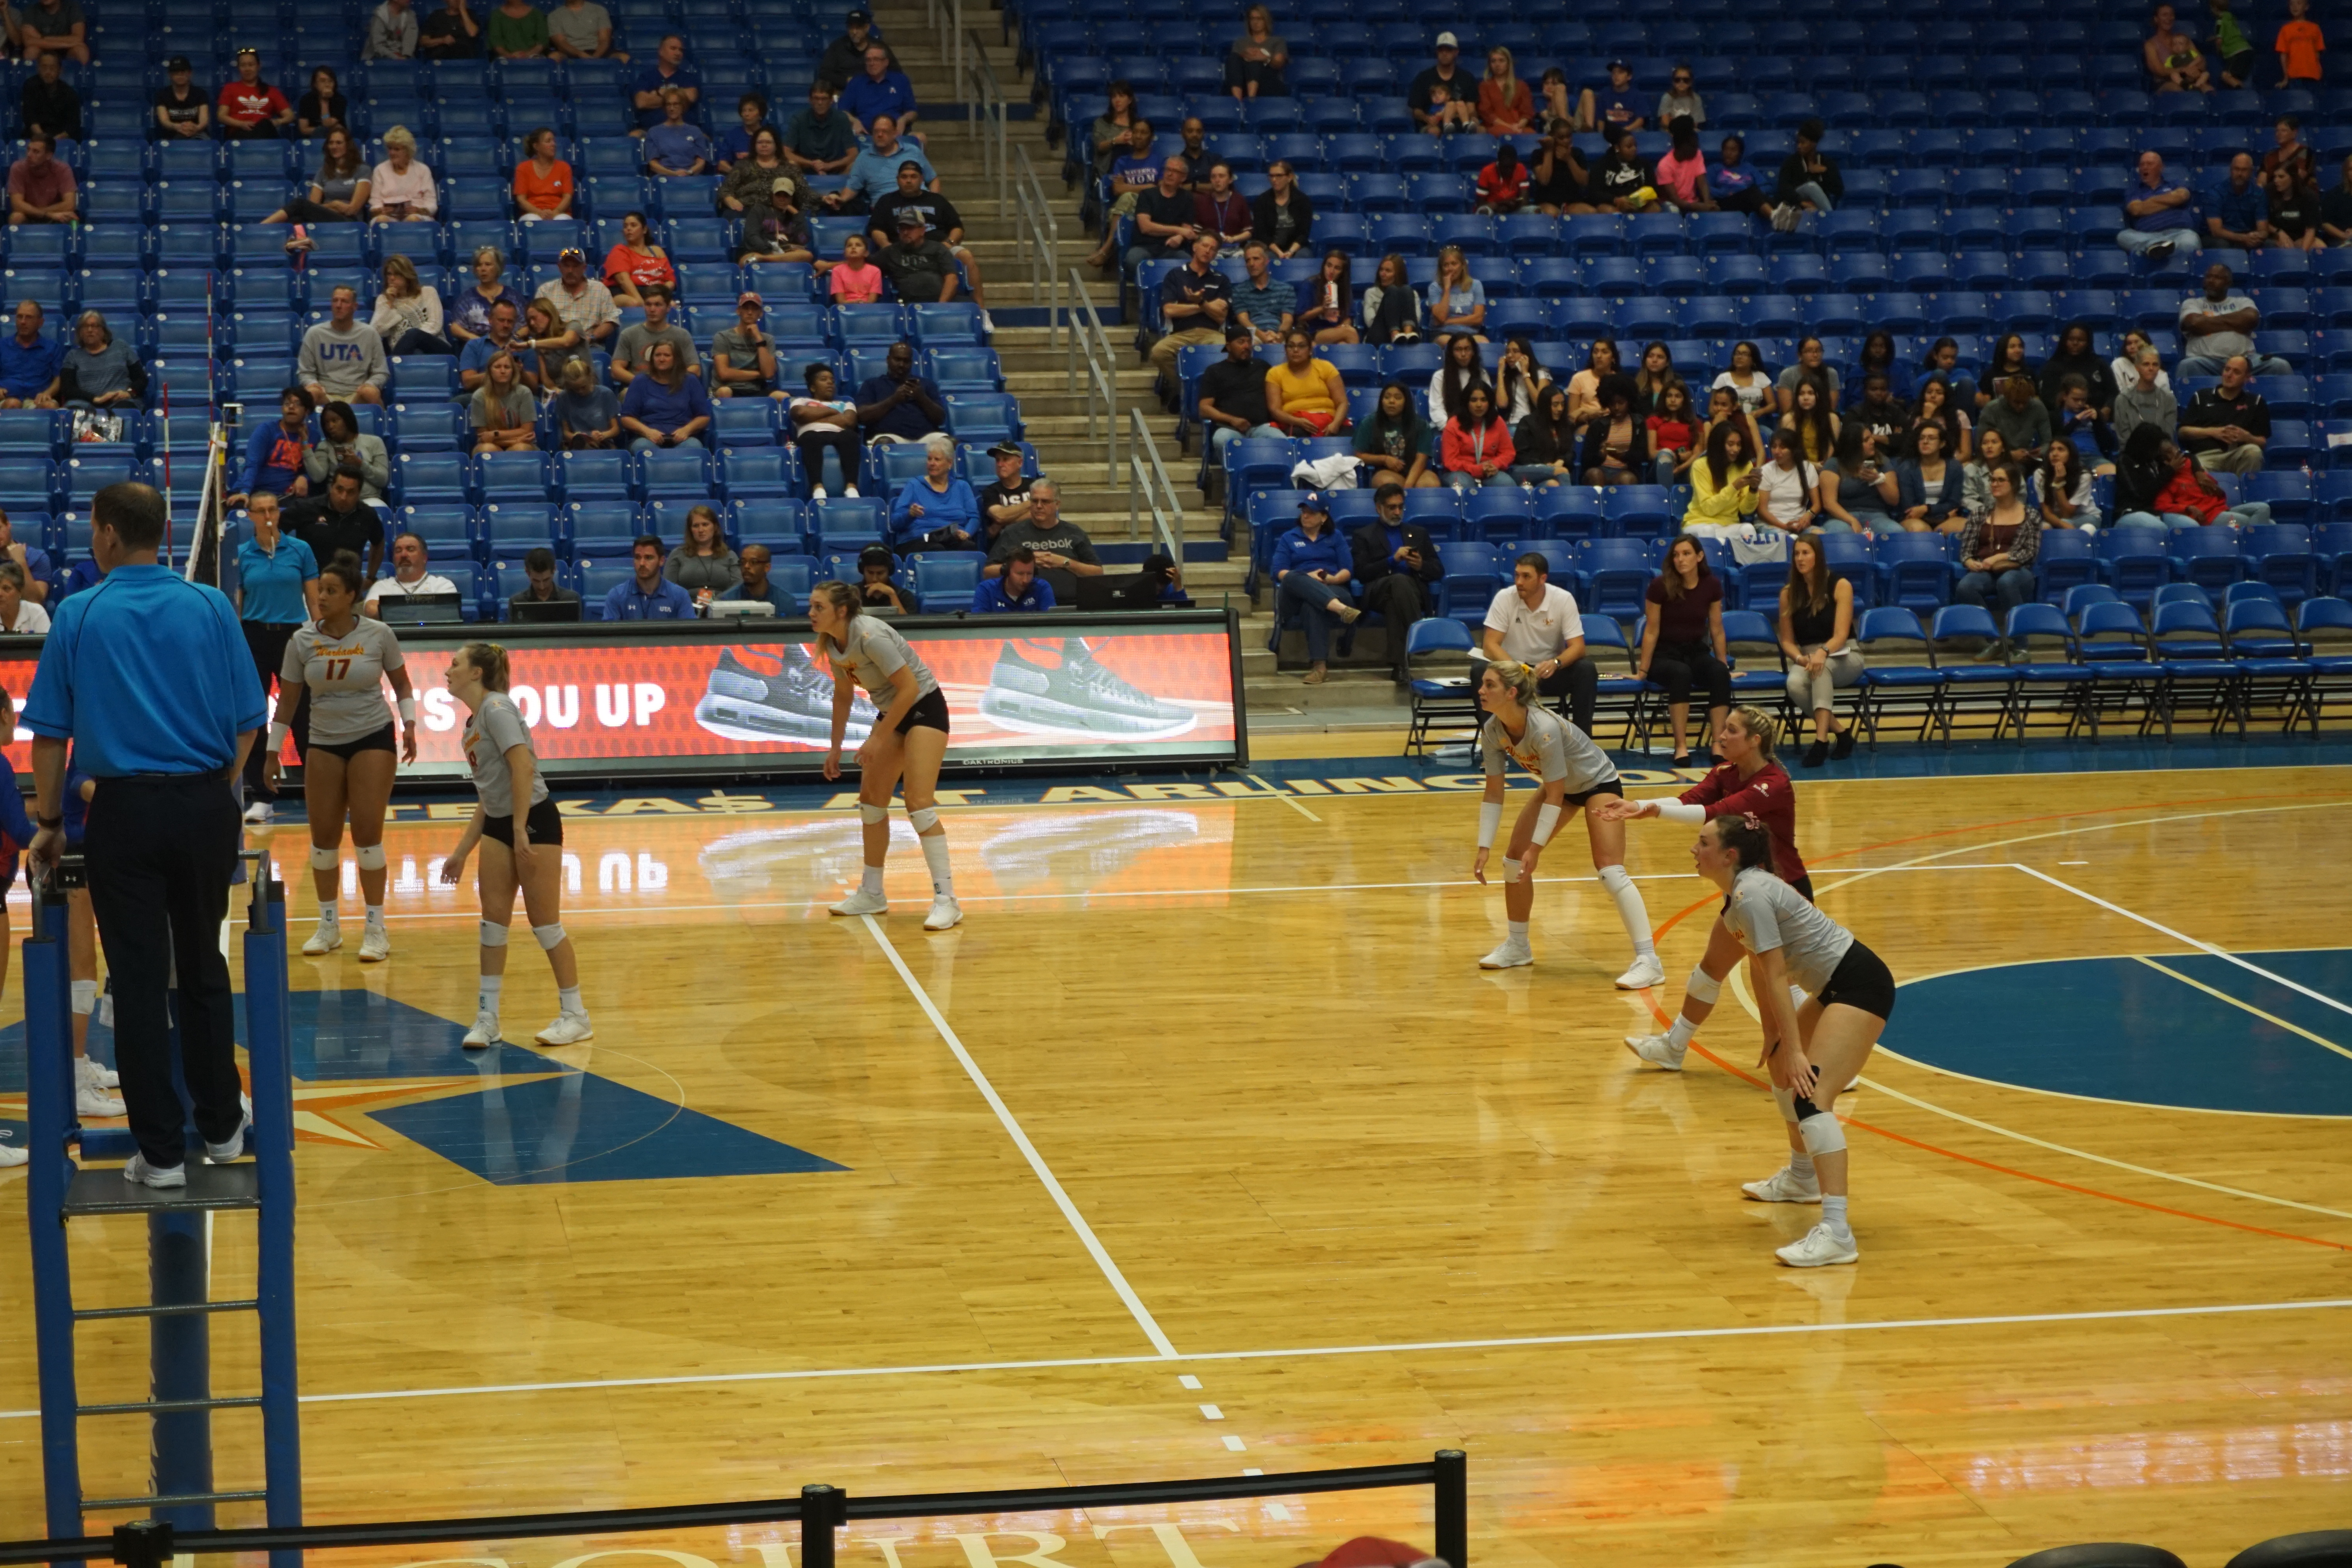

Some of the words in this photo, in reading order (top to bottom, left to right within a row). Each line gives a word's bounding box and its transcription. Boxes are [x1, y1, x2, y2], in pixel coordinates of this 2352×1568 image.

[319, 343, 363, 361] UTA
[326, 658, 352, 681] 17
[509, 684, 579, 729] OU
[596, 683, 665, 726] UP
[1521, 762, 1542, 775] 15
